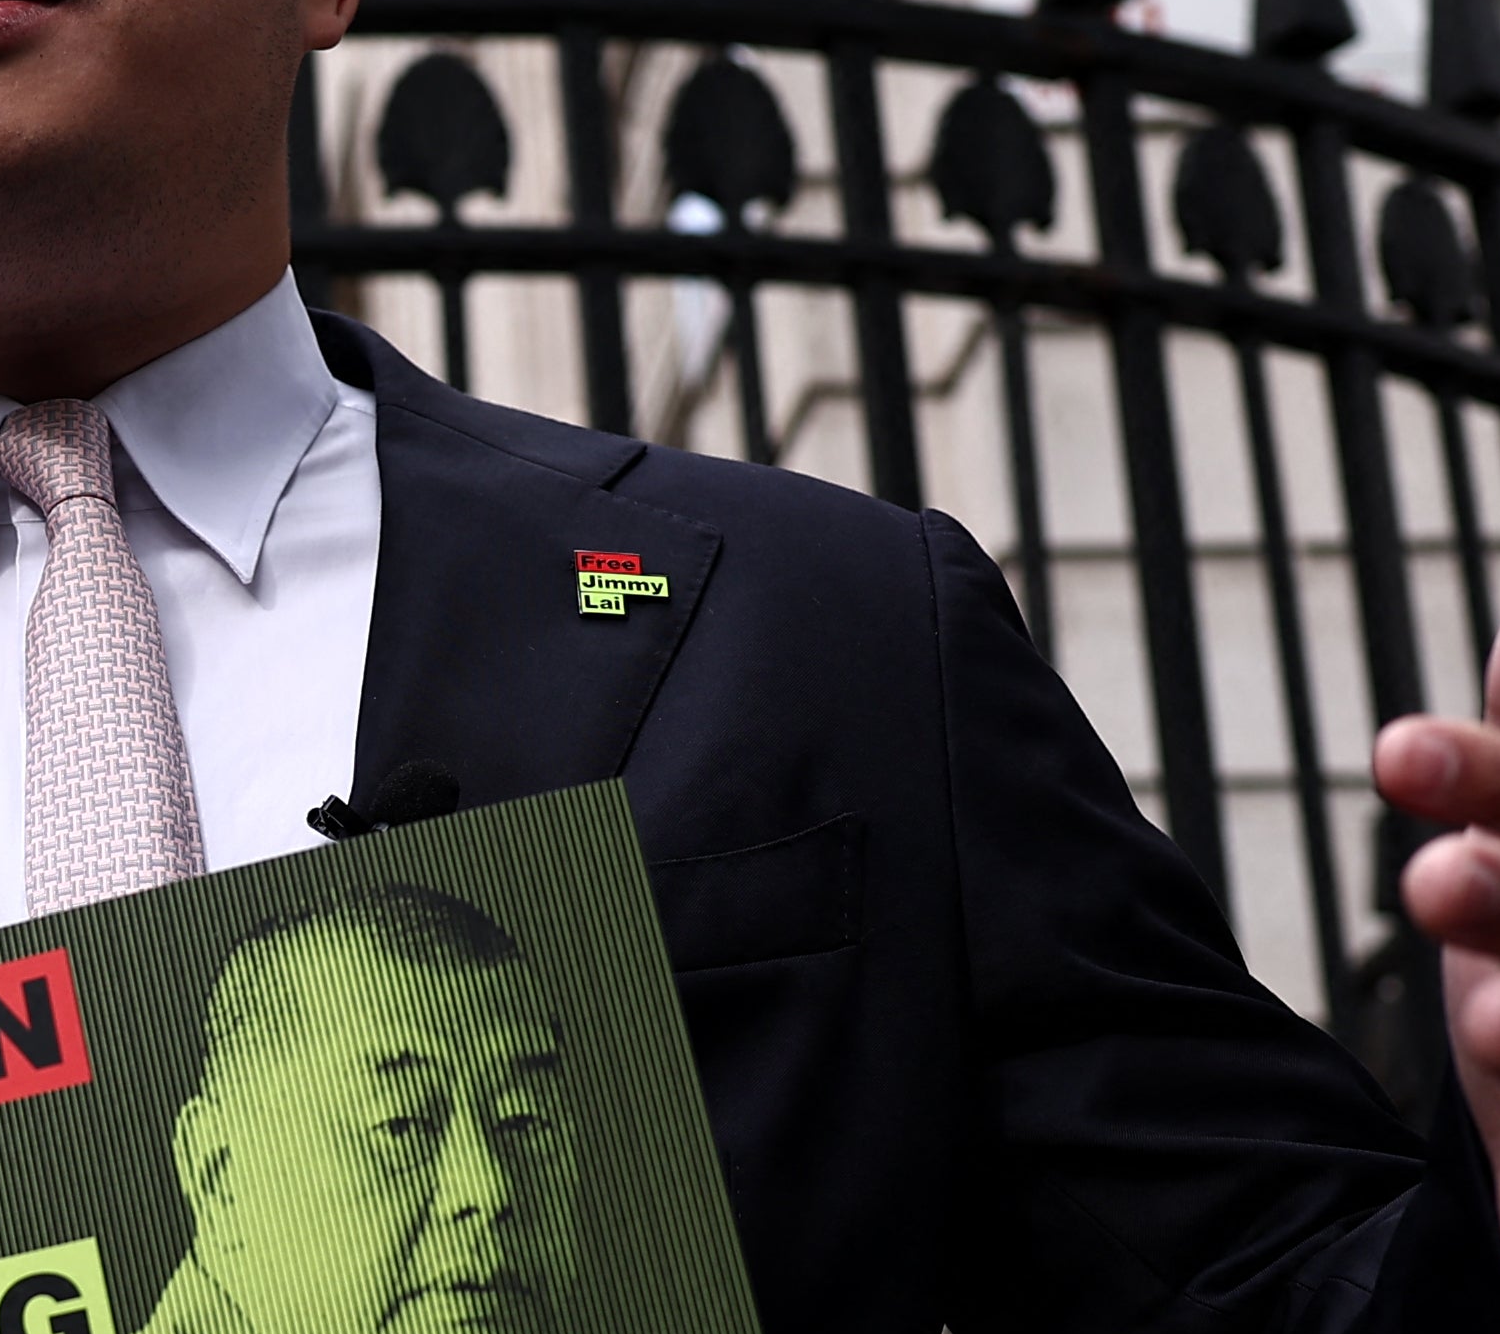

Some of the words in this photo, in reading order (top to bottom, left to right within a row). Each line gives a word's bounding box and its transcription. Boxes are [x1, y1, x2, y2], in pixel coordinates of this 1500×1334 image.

[581, 555, 636, 571] Free
[582, 575, 663, 595] Jimmy
[584, 595, 620, 610] Lai
